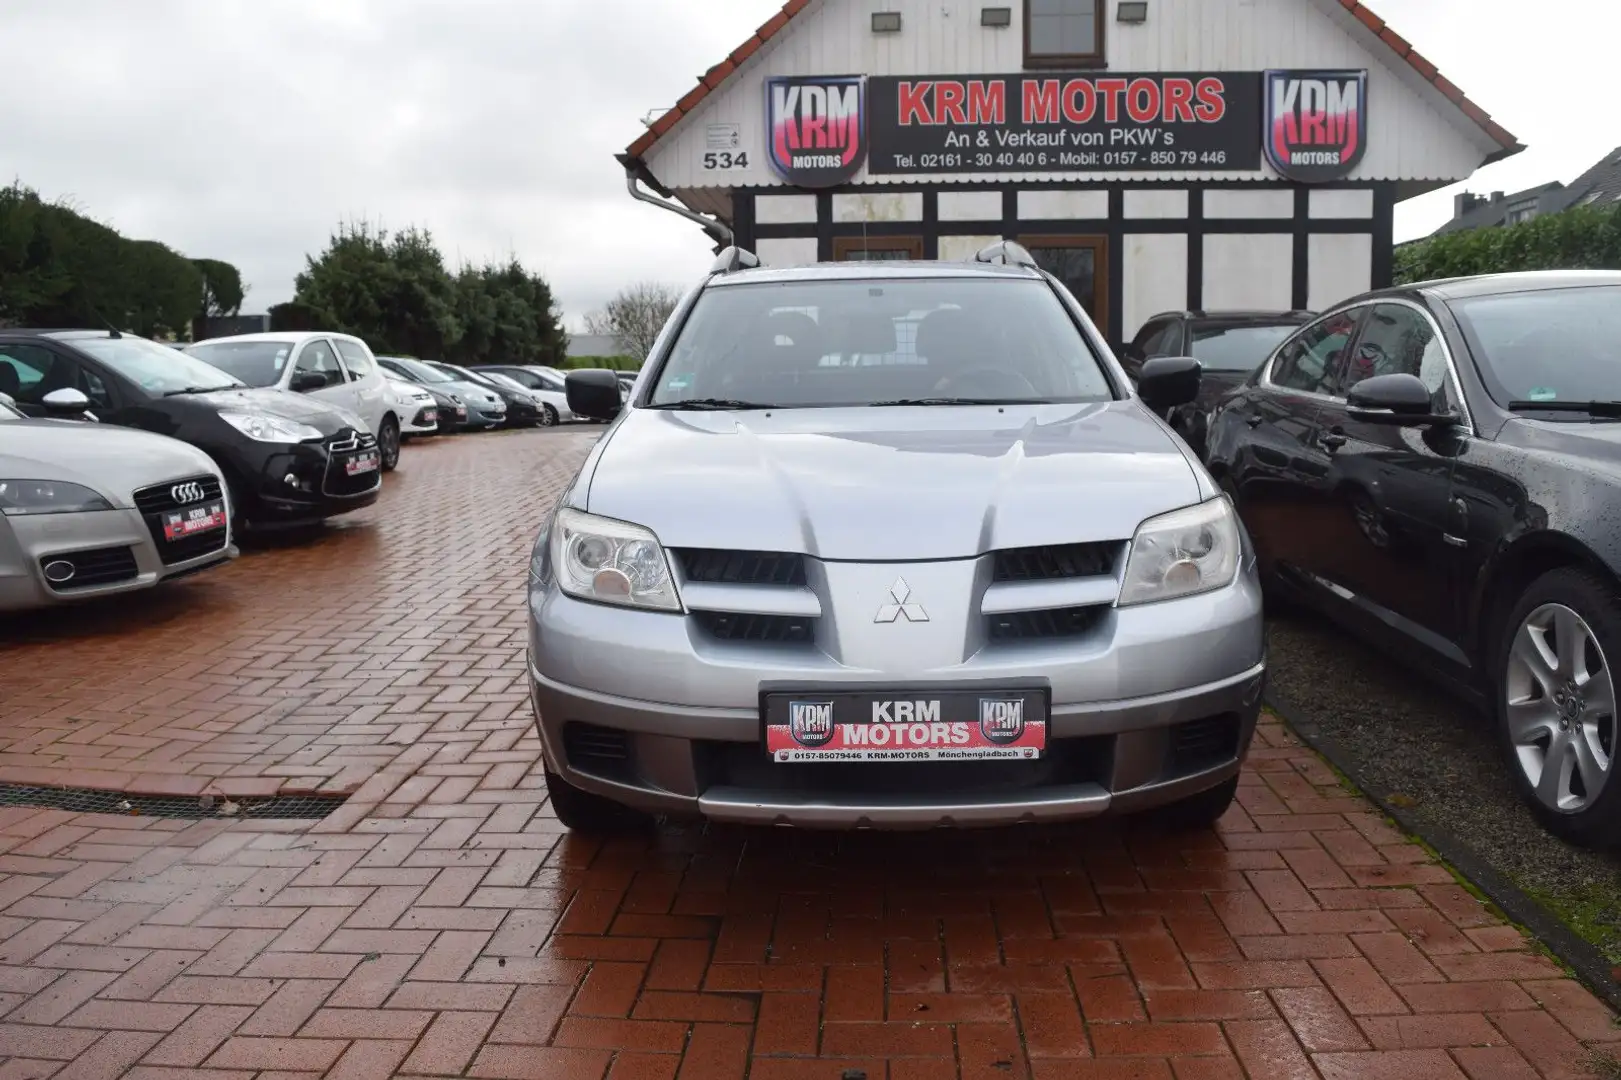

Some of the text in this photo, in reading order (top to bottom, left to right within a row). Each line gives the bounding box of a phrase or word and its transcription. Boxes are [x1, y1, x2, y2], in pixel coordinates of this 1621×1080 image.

[898, 77, 1226, 125] KRM MOTORS
[1274, 79, 1358, 145] KRM
[774, 85, 858, 149] KRM
[944, 130, 970, 147] An
[976, 130, 990, 147] &
[995, 129, 1067, 147] Verkauf
[1071, 132, 1104, 146] von
[704, 151, 749, 169] 534
[793, 155, 842, 168] MOTORS
[893, 154, 917, 167] Tel.
[920, 154, 962, 167] 02161
[976, 153, 993, 166] 30
[996, 153, 1014, 166] 40
[1017, 152, 1035, 165] 40
[1037, 152, 1047, 165] 6
[1060, 152, 1100, 165] Mobil:
[1103, 152, 1137, 164] 0157
[1150, 151, 1176, 164] 850
[1180, 151, 1197, 164] 79
[1200, 151, 1226, 164] 446
[1291, 152, 1340, 165] MOTORS
[793, 705, 831, 731] KRM
[872, 700, 941, 723] KRM
[983, 702, 1021, 728] KRM
[843, 722, 970, 745] MOTORS
[938, 750, 1019, 759] Mönchengladbach
